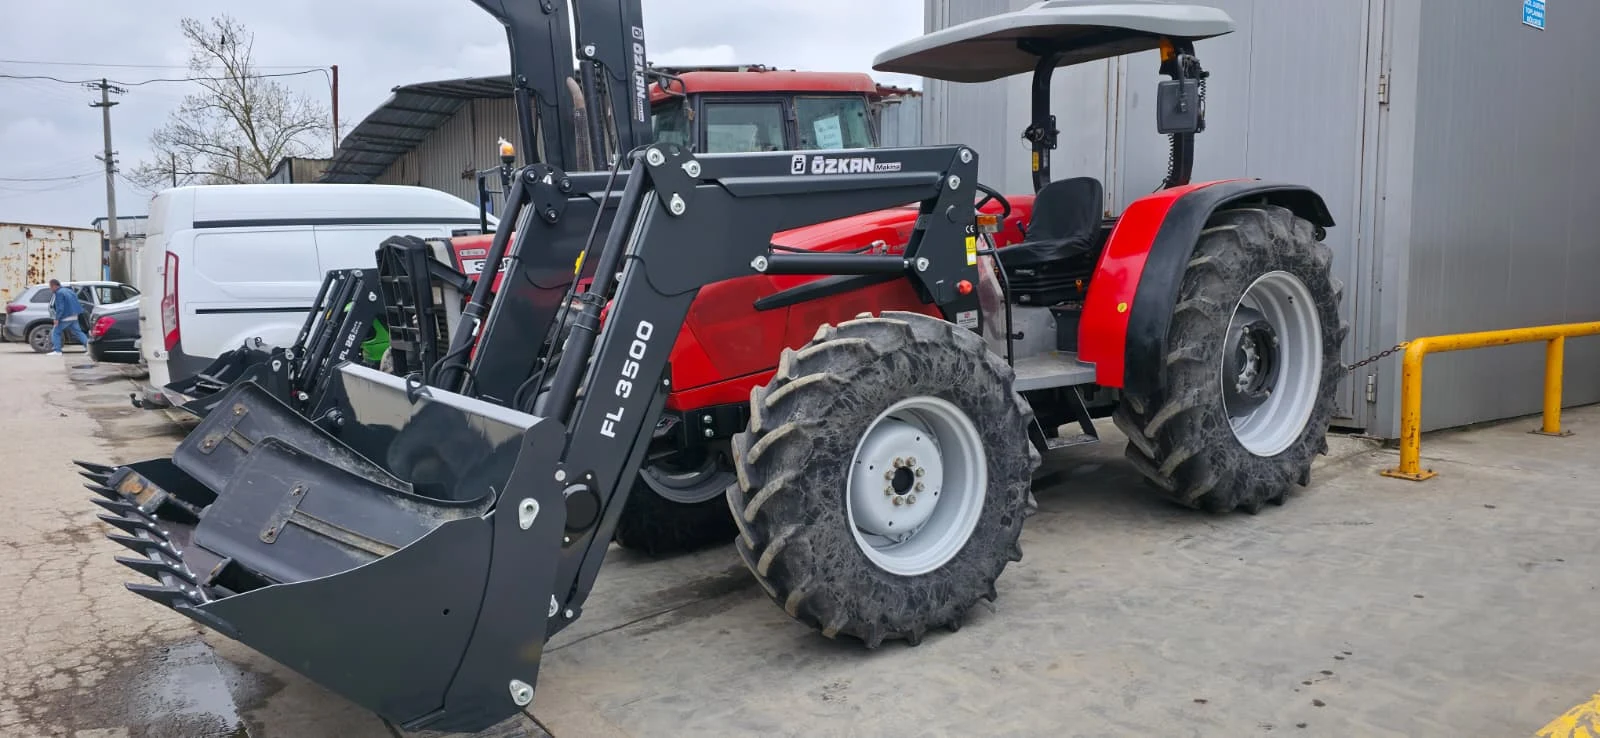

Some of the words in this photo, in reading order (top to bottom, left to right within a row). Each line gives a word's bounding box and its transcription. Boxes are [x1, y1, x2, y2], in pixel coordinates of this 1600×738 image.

[811, 156, 876, 174] ÖZKAN
[600, 407, 625, 438] FL
[615, 320, 654, 399] 3500
